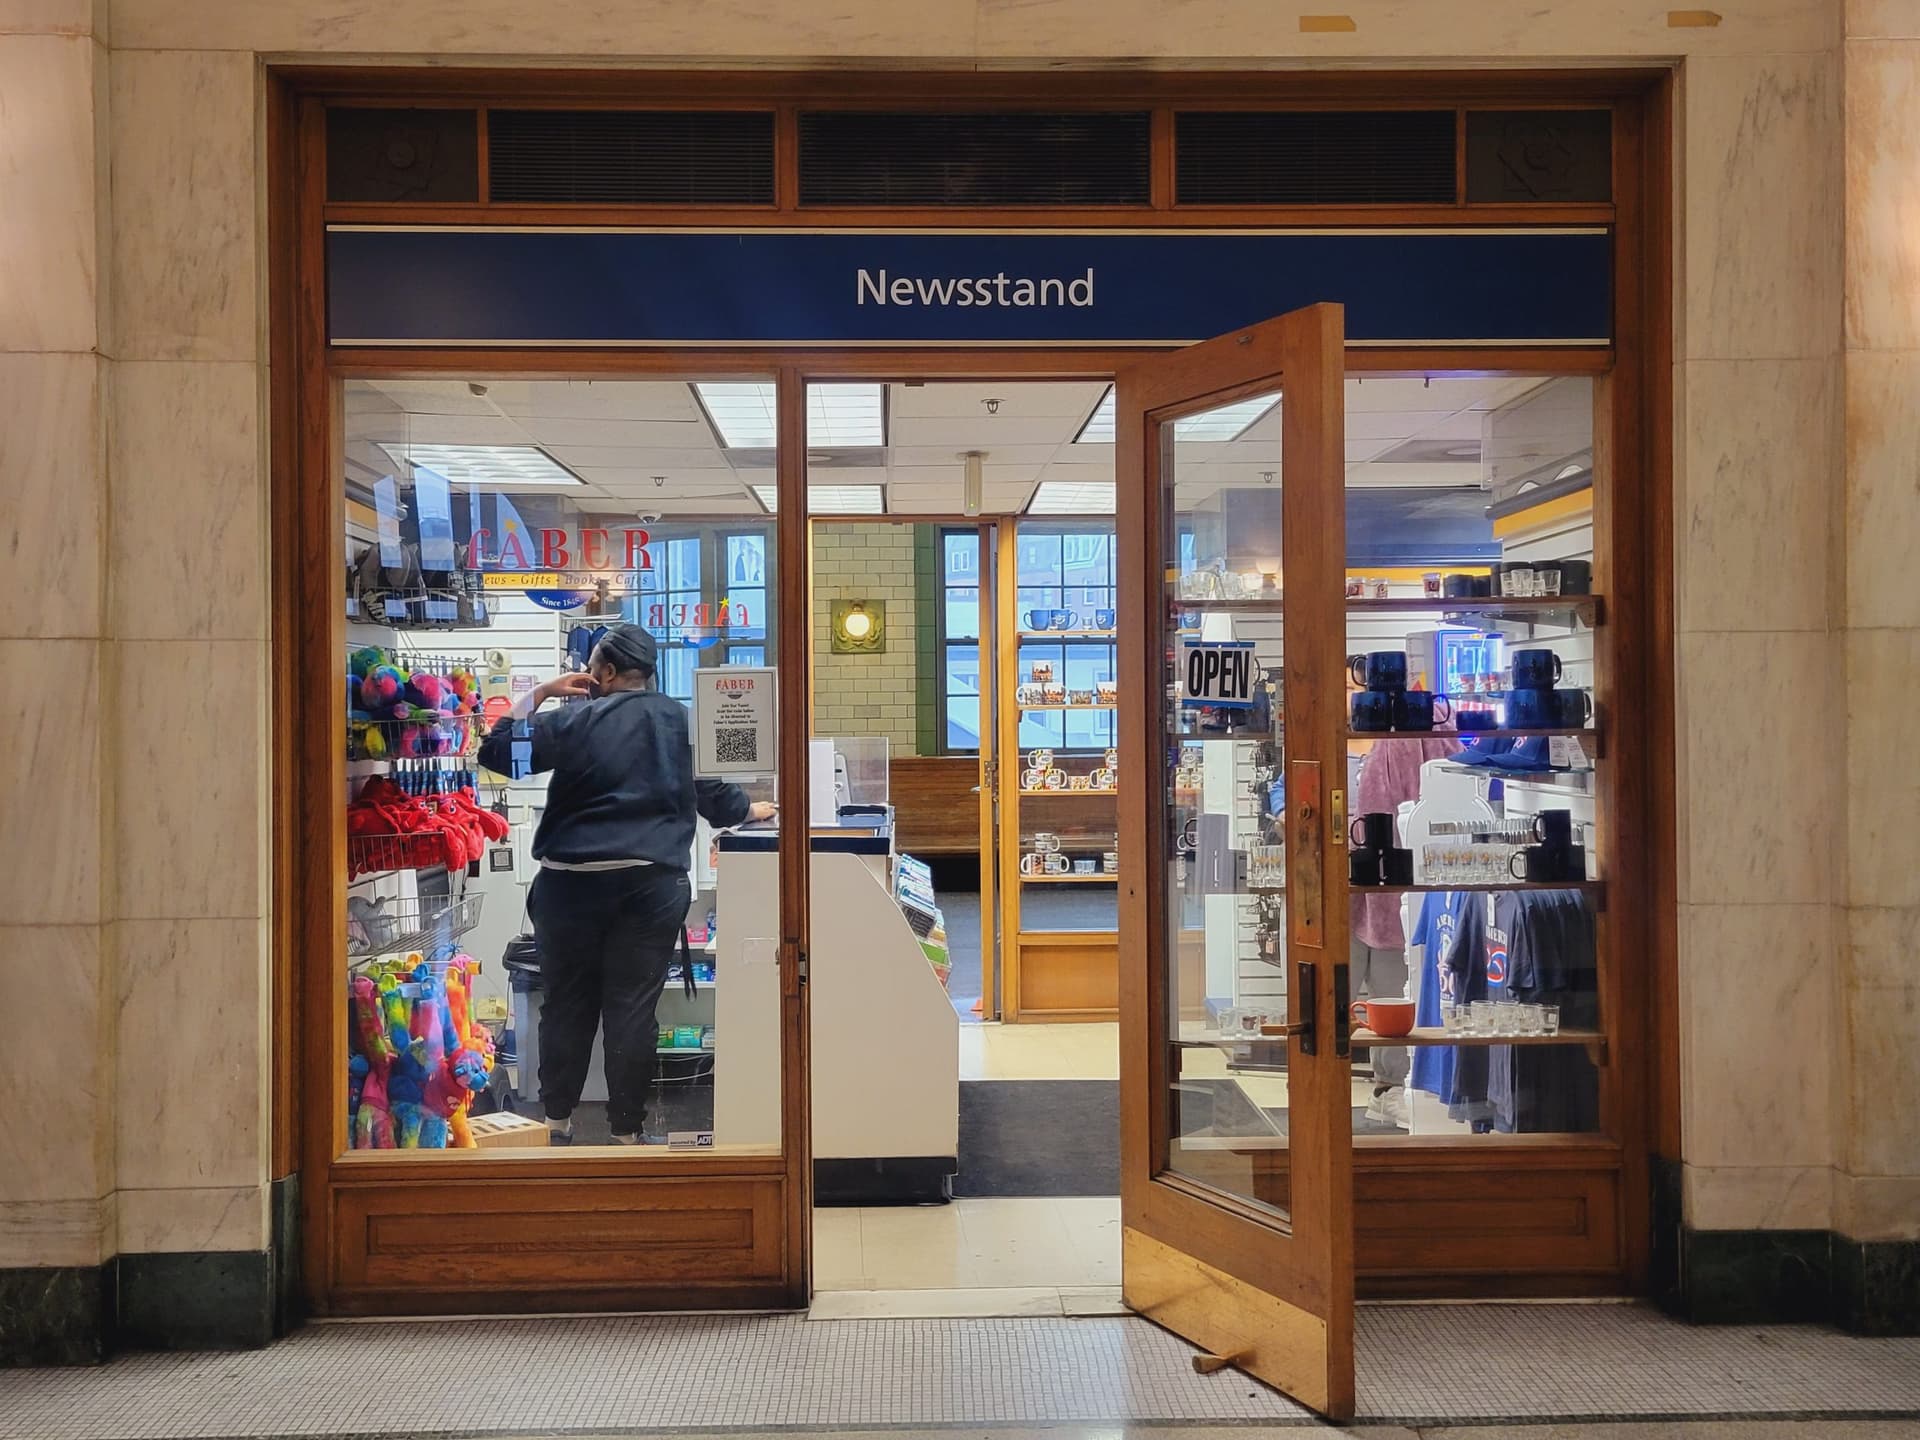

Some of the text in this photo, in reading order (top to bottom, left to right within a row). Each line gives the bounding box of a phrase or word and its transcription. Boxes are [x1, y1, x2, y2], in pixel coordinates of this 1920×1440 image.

[857, 268, 1094, 307] Newsstand
[465, 527, 653, 569] FABER
[520, 573, 552, 587] Gifts
[615, 573, 648, 587] Cafs
[541, 596, 561, 607] Since
[1188, 649, 1250, 699] OPEN
[715, 679, 755, 690] FABER
[697, 1136, 712, 1145] ADT
